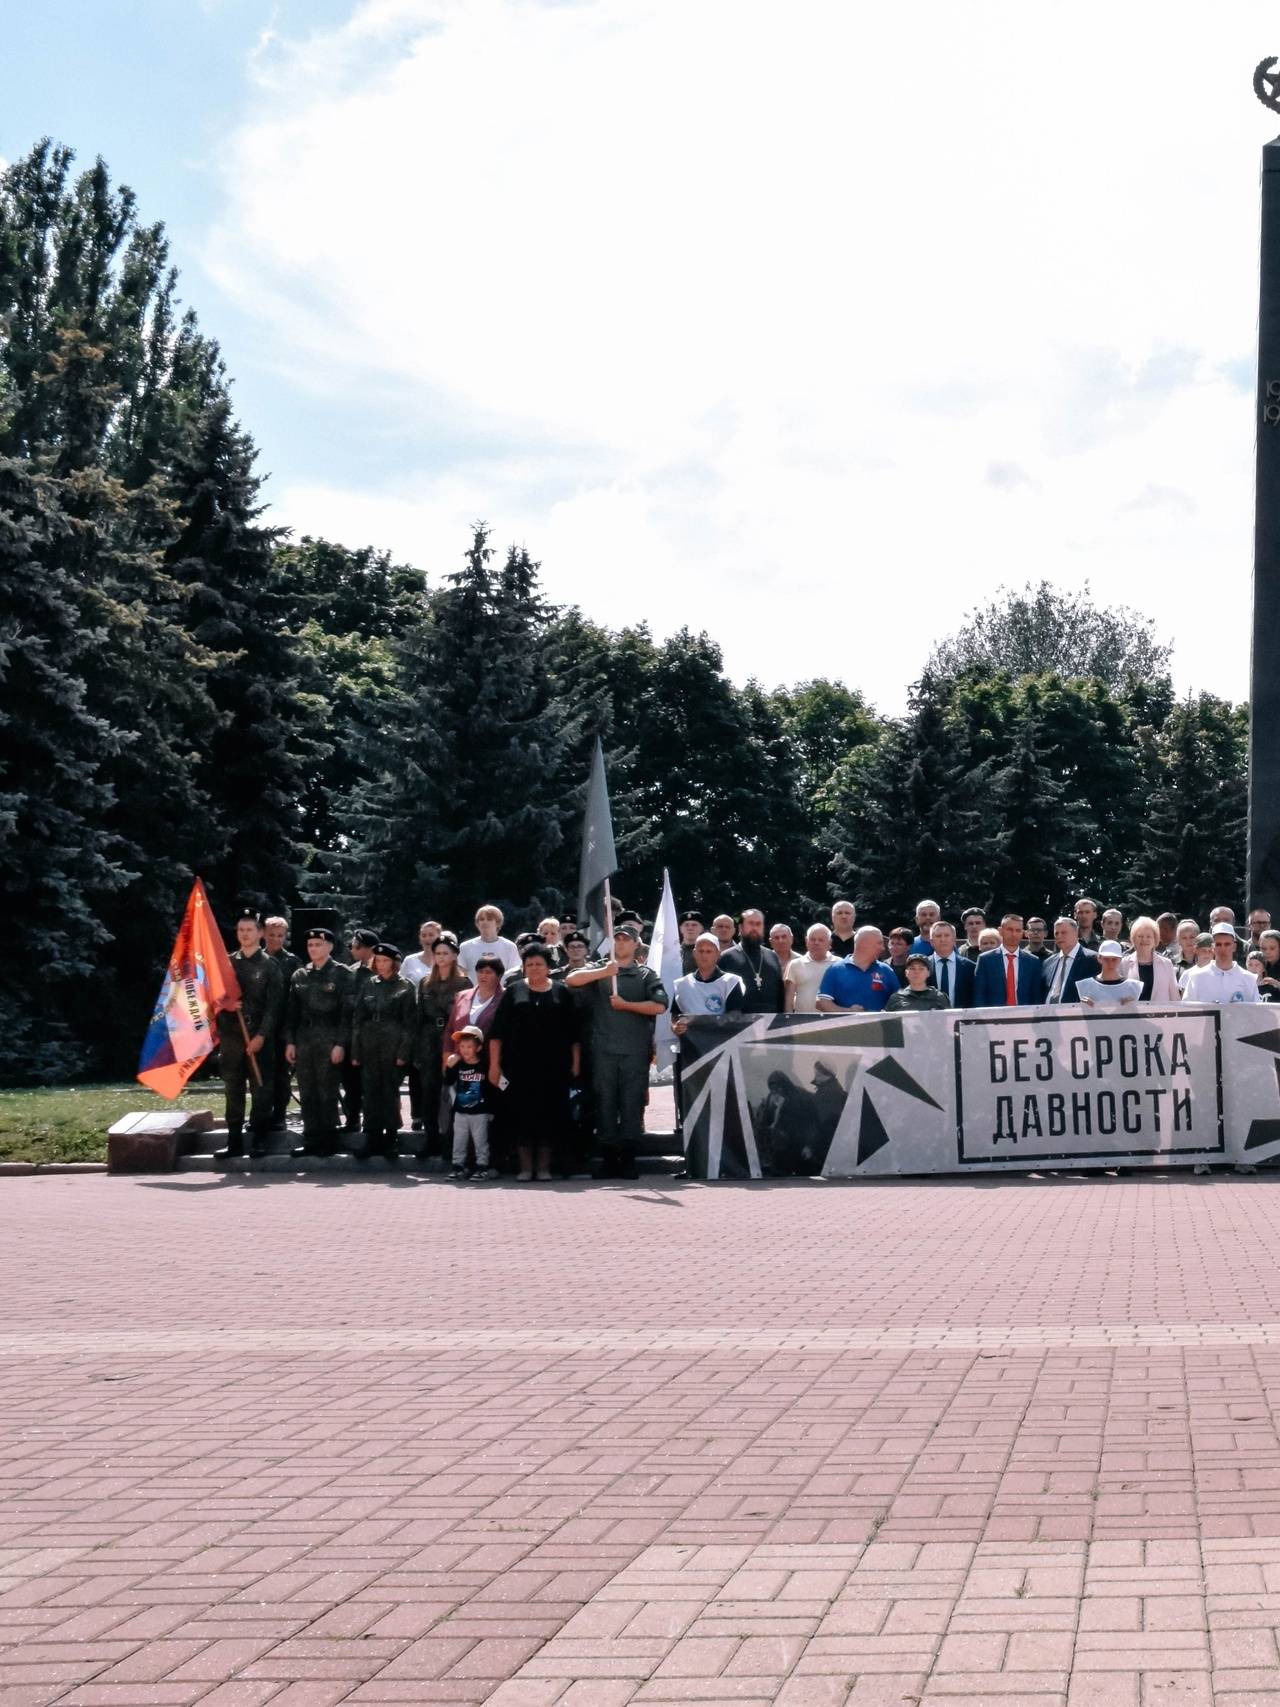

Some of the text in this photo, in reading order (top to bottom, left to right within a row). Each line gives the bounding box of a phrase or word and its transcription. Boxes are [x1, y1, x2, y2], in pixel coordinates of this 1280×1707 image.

[989, 1033, 1192, 1083] БЕЗ СРОКА
[993, 1088, 1192, 1144] ДАВНОСТИ
